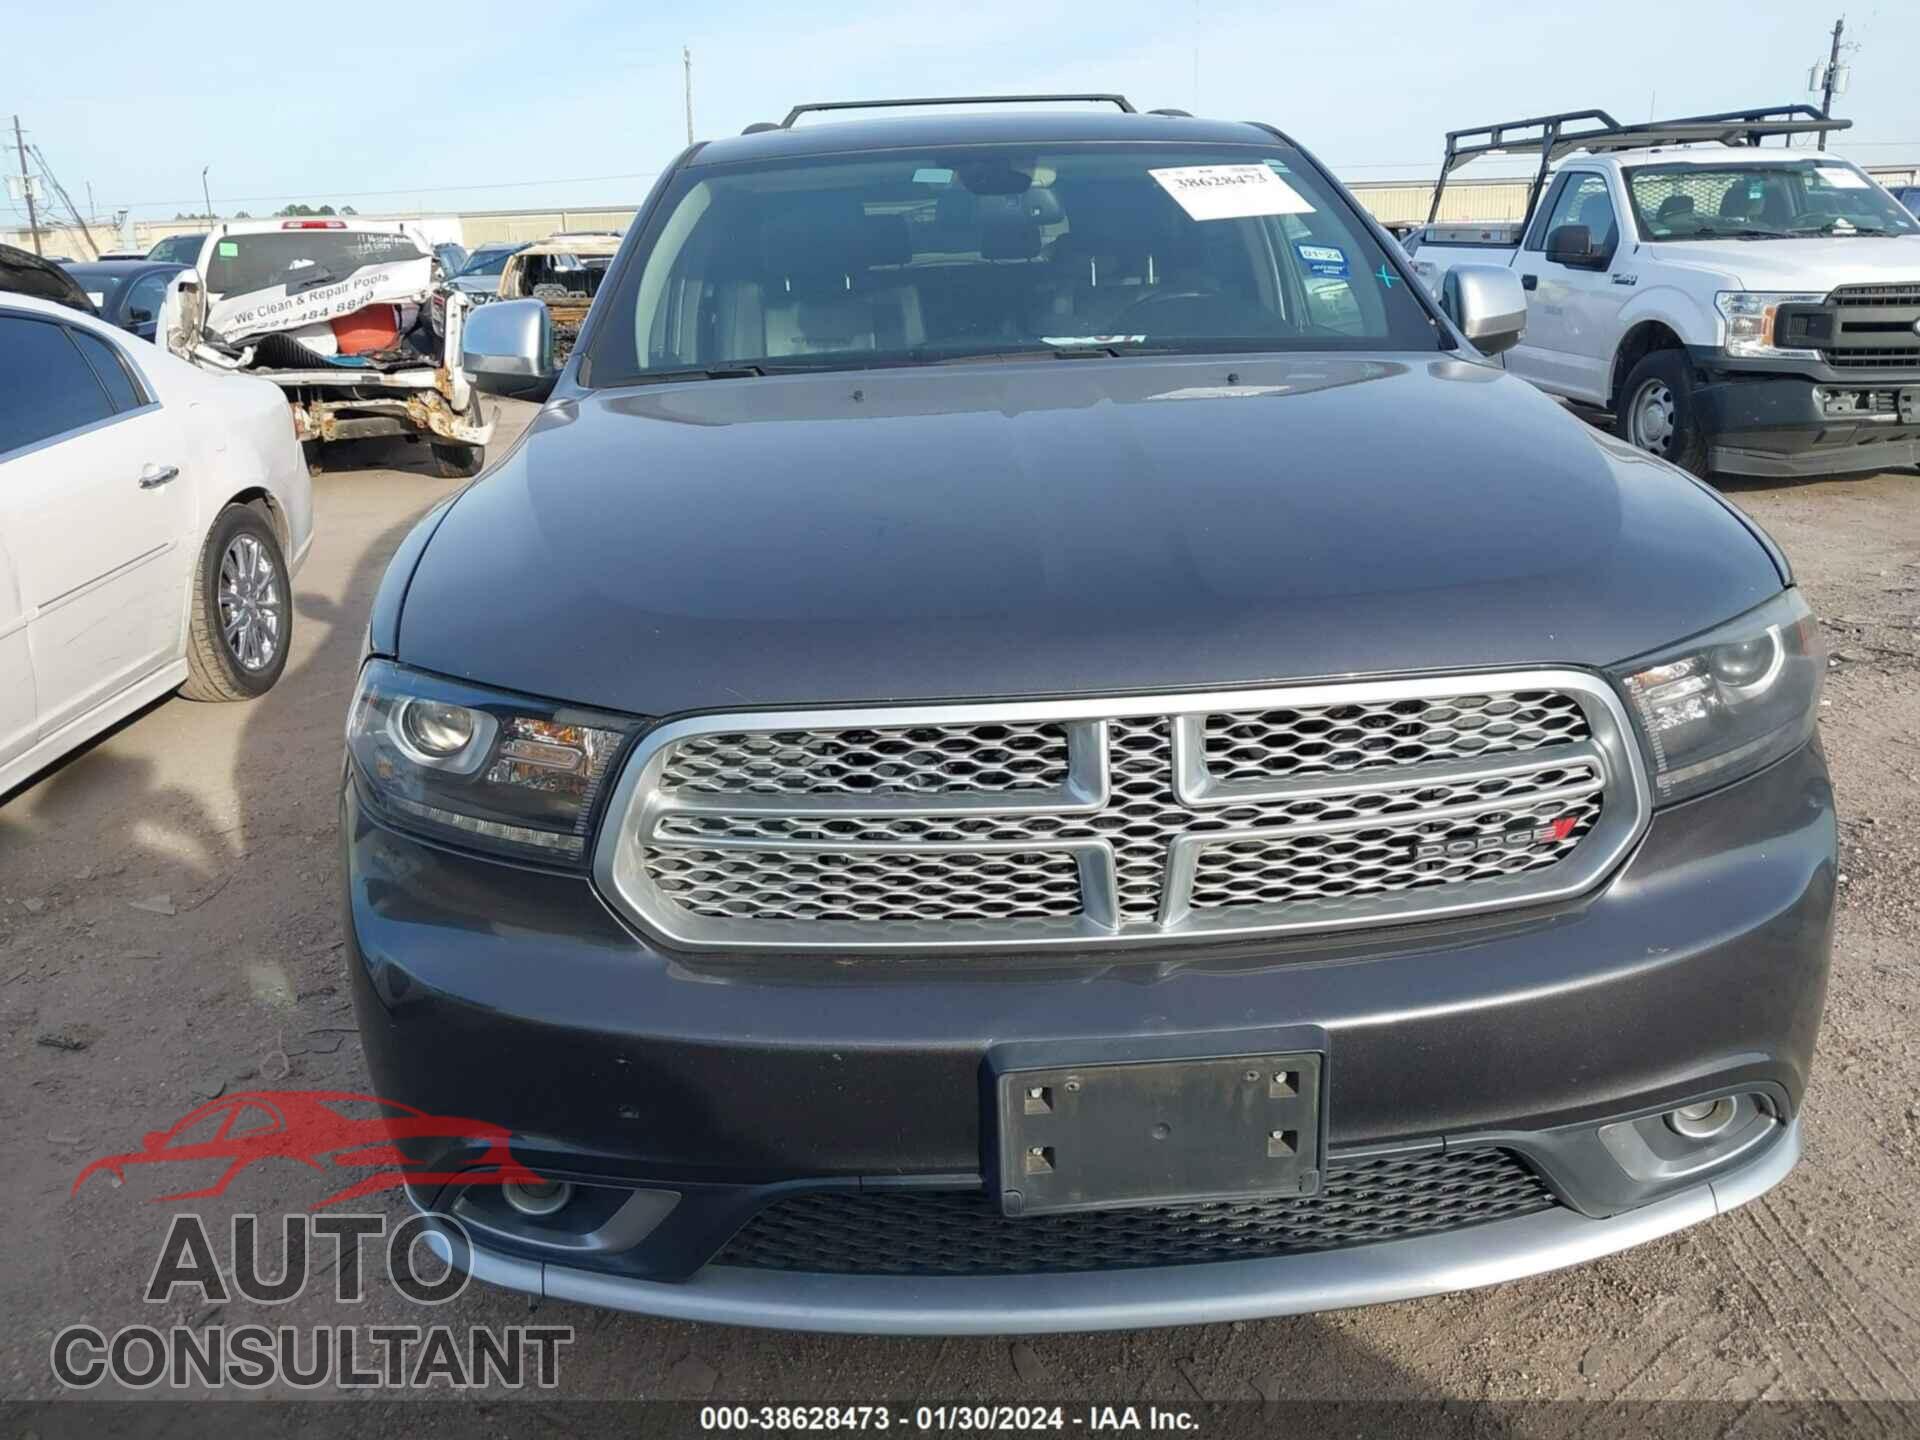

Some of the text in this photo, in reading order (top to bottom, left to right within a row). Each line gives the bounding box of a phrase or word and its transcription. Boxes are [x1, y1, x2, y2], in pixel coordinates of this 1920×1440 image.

[234, 272, 390, 324] We Clean & Repair Pools
[1415, 825, 1557, 859] DODGE
